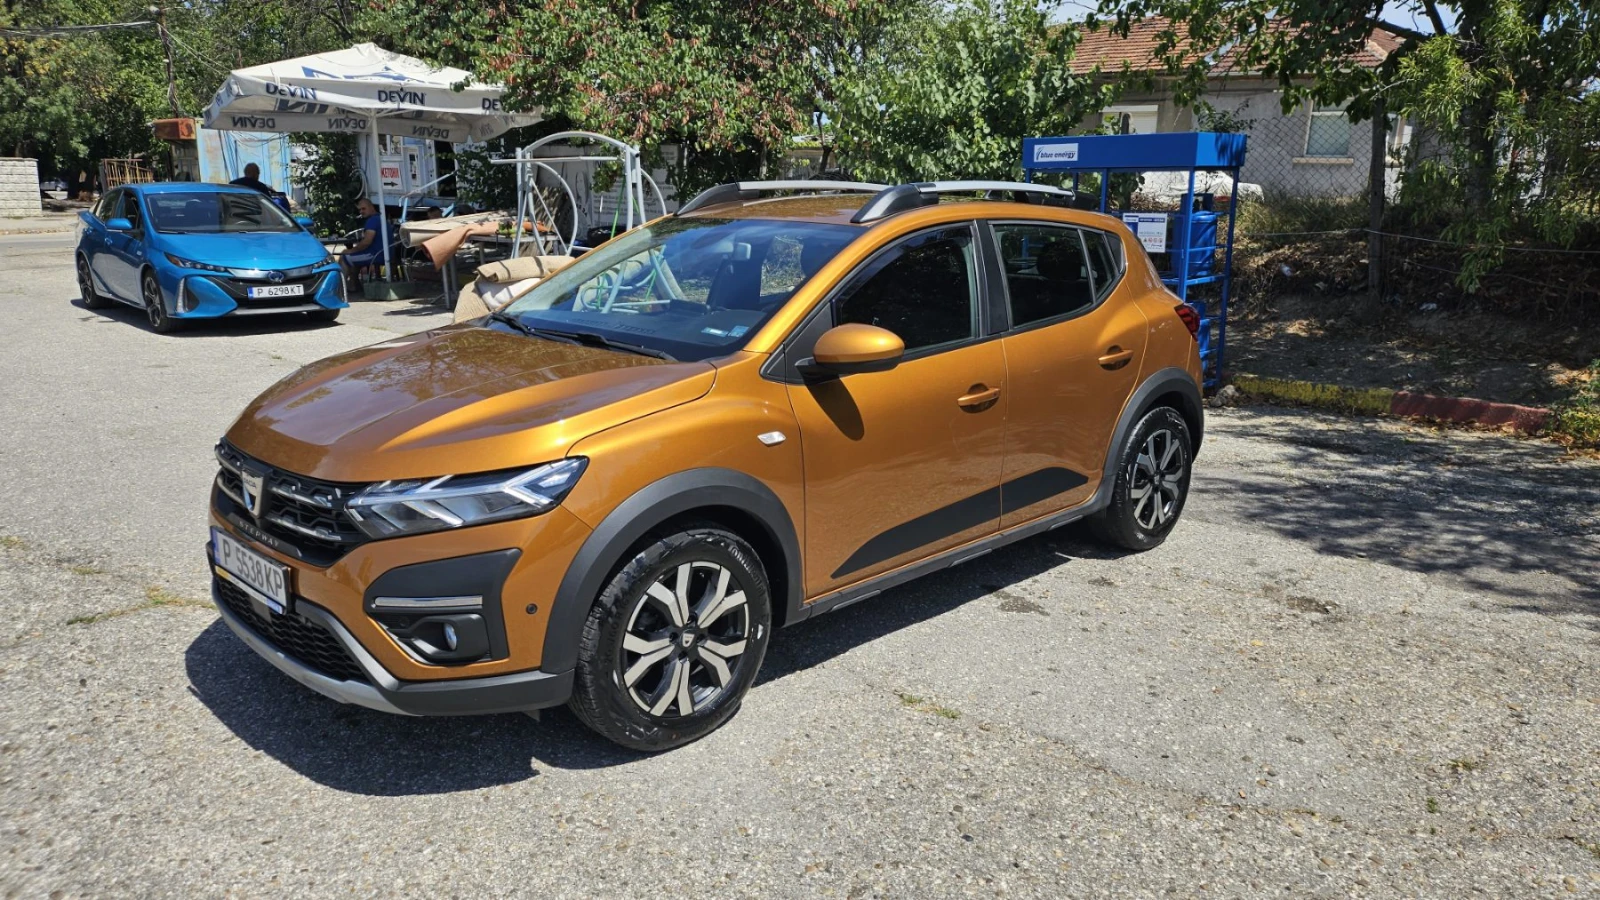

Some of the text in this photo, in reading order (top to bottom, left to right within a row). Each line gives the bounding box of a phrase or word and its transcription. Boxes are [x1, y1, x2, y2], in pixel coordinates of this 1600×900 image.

[266, 82, 317, 100] DEVIN
[377, 88, 425, 105] DEVIN
[268, 285, 302, 296] 6298KT
[239, 521, 280, 548] STEPWAY
[222, 538, 283, 598] P 5538KP
